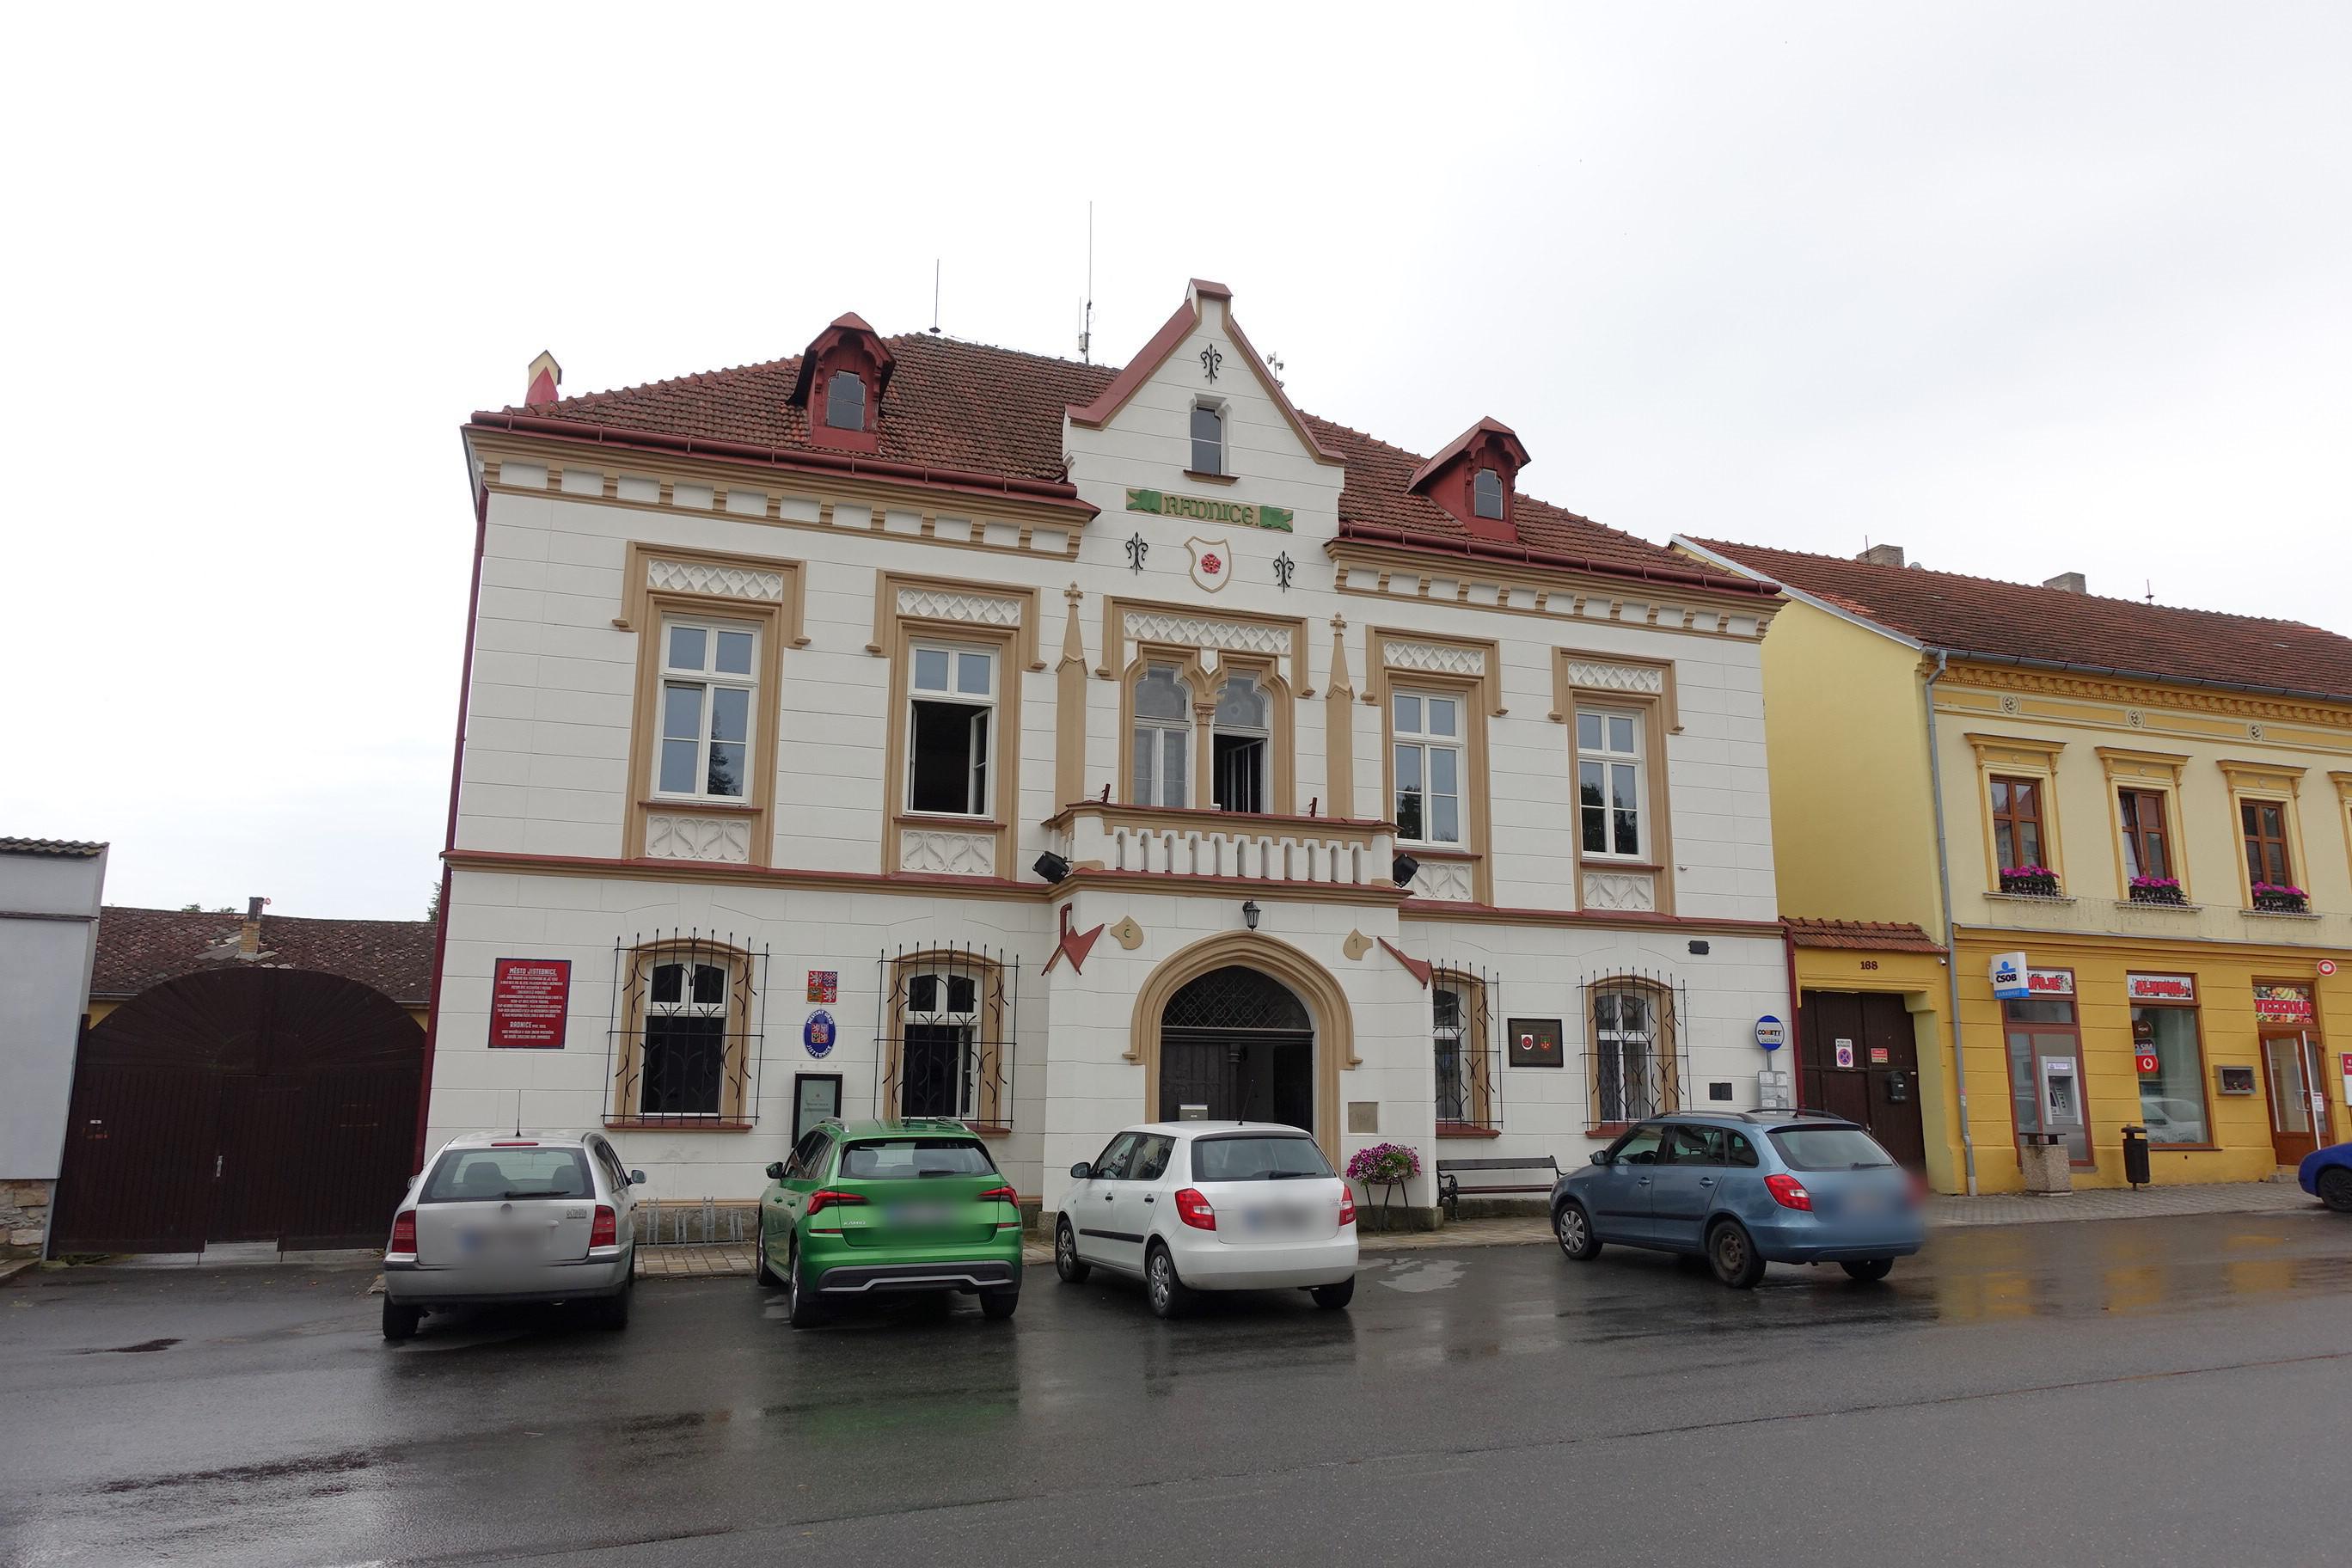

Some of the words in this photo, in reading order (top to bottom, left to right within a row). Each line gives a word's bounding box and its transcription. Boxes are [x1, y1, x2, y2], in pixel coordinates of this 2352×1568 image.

[509, 966, 526, 975] MĚSTO
[1860, 960, 1878, 971] 168
[1996, 972, 2017, 983] ČSOB
[806, 1044, 832, 1057] JISTEBNICE
